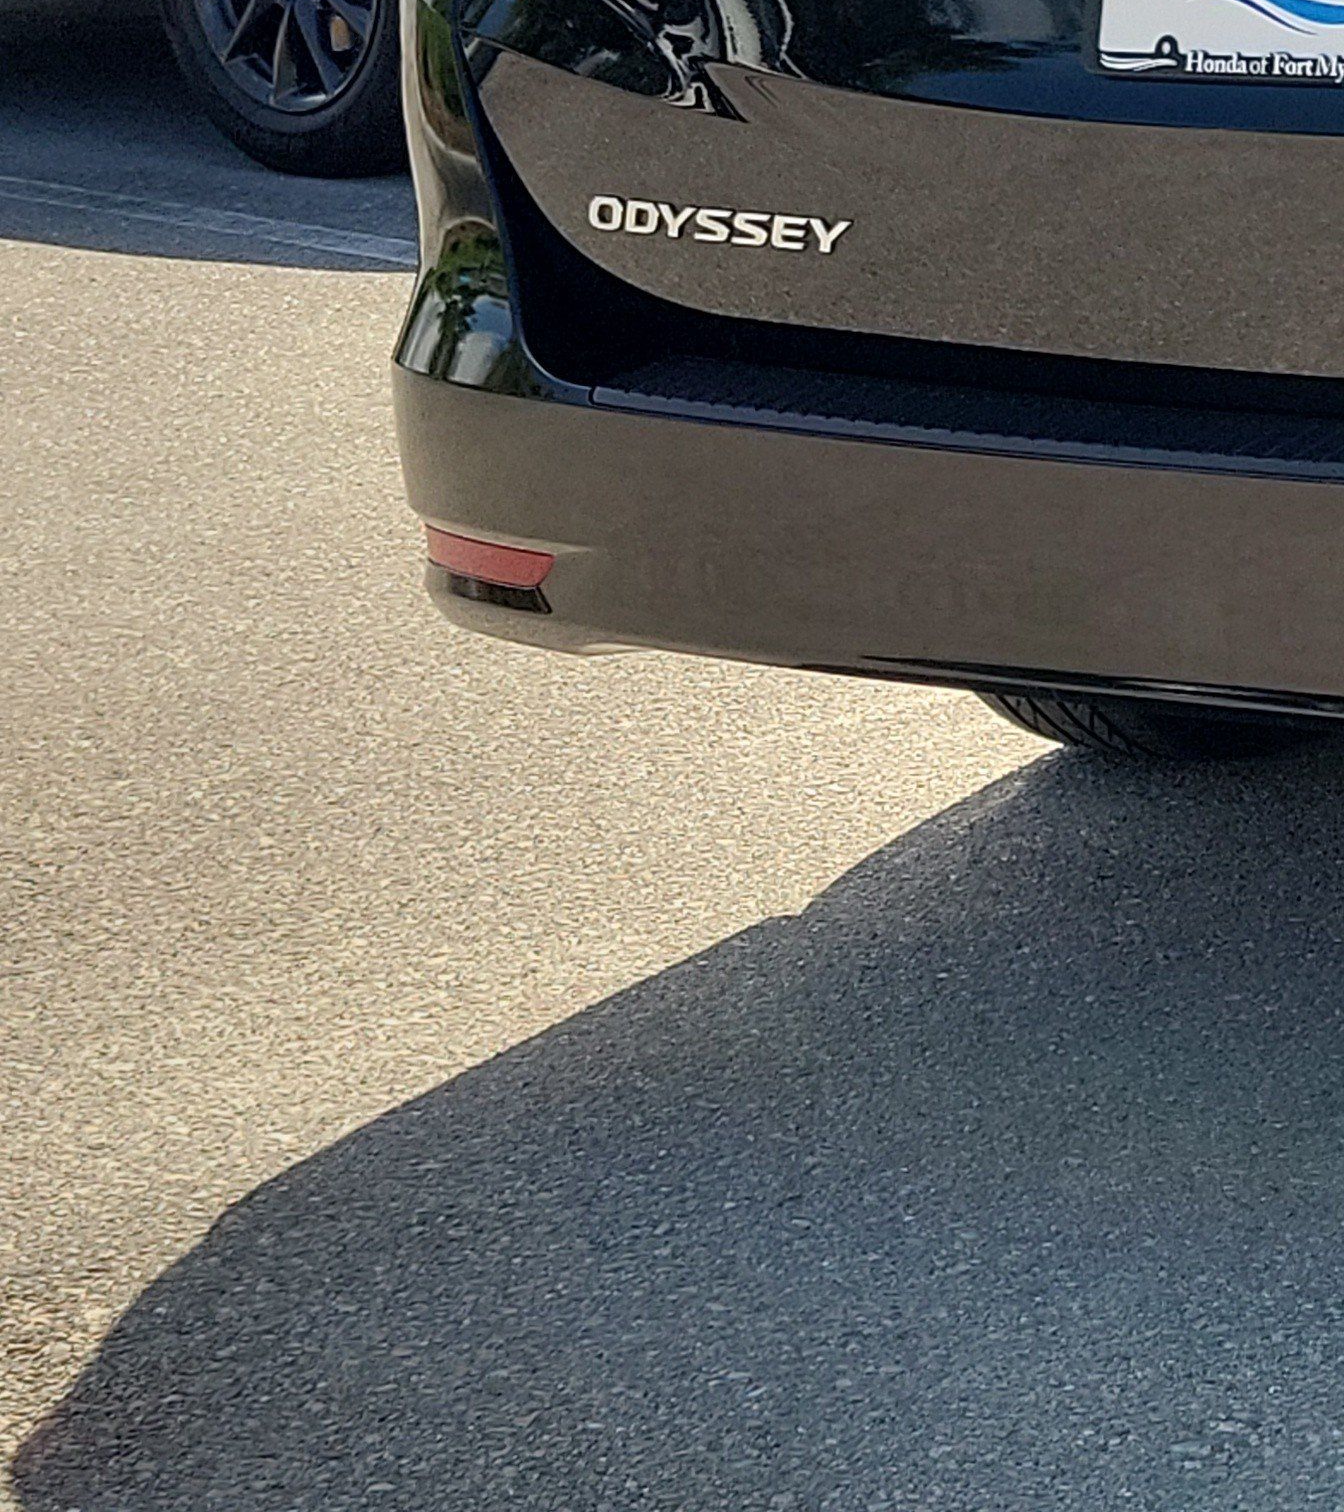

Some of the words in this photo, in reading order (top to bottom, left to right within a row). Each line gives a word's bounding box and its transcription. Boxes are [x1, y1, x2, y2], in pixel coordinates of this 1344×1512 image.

[1184, 50, 1248, 75] Honda
[1249, 53, 1268, 75] of
[1270, 52, 1314, 76] Fort
[587, 194, 853, 254] ODYSSEY
